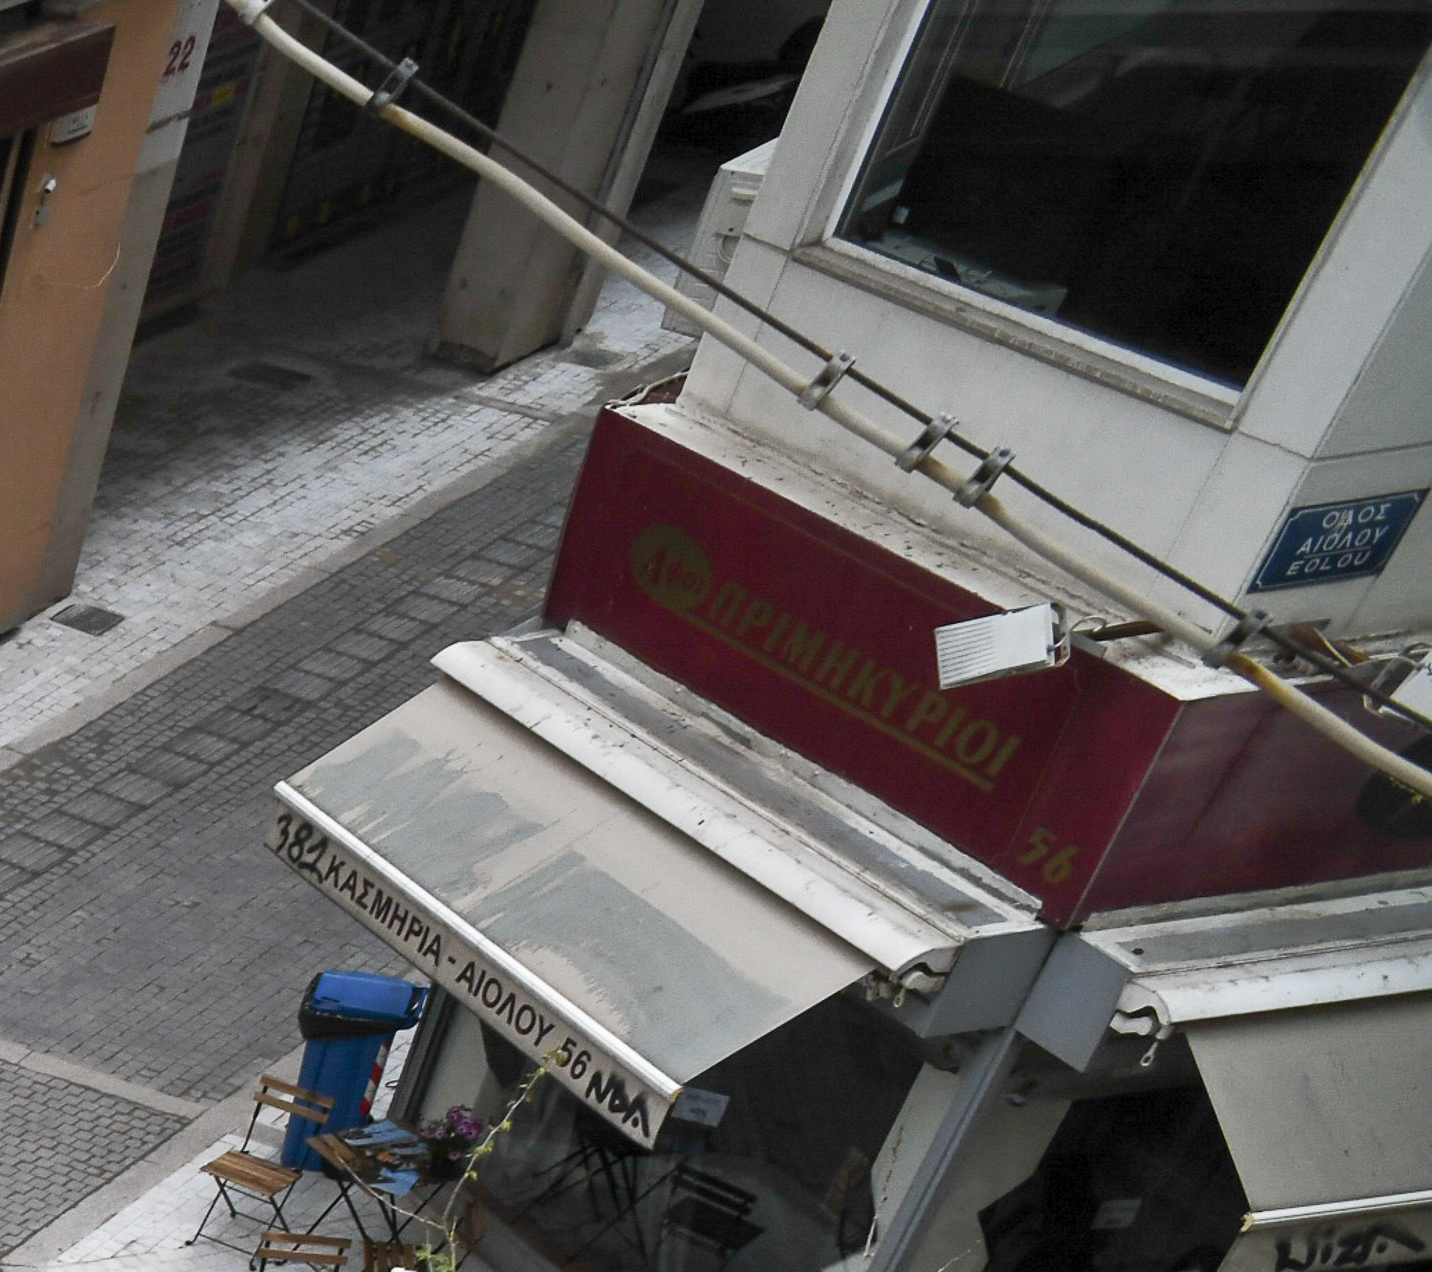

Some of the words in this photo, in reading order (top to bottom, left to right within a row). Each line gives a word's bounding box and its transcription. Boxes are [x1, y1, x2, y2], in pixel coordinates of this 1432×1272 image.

[162, 36, 196, 76] 22
[1285, 551, 1372, 576] EOLOU
[1294, 525, 1390, 556] ΑΙΟΛΟΥ
[711, 580, 1024, 779] ΠΡΙΜΗΚΥΡΙΟΙ
[1014, 827, 1078, 887] 56
[324, 855, 444, 968] ΚΑΣΜΗΡΙΑ
[456, 962, 557, 1049] ΑΙΟΛΟΥ
[557, 1036, 592, 1081] 56
